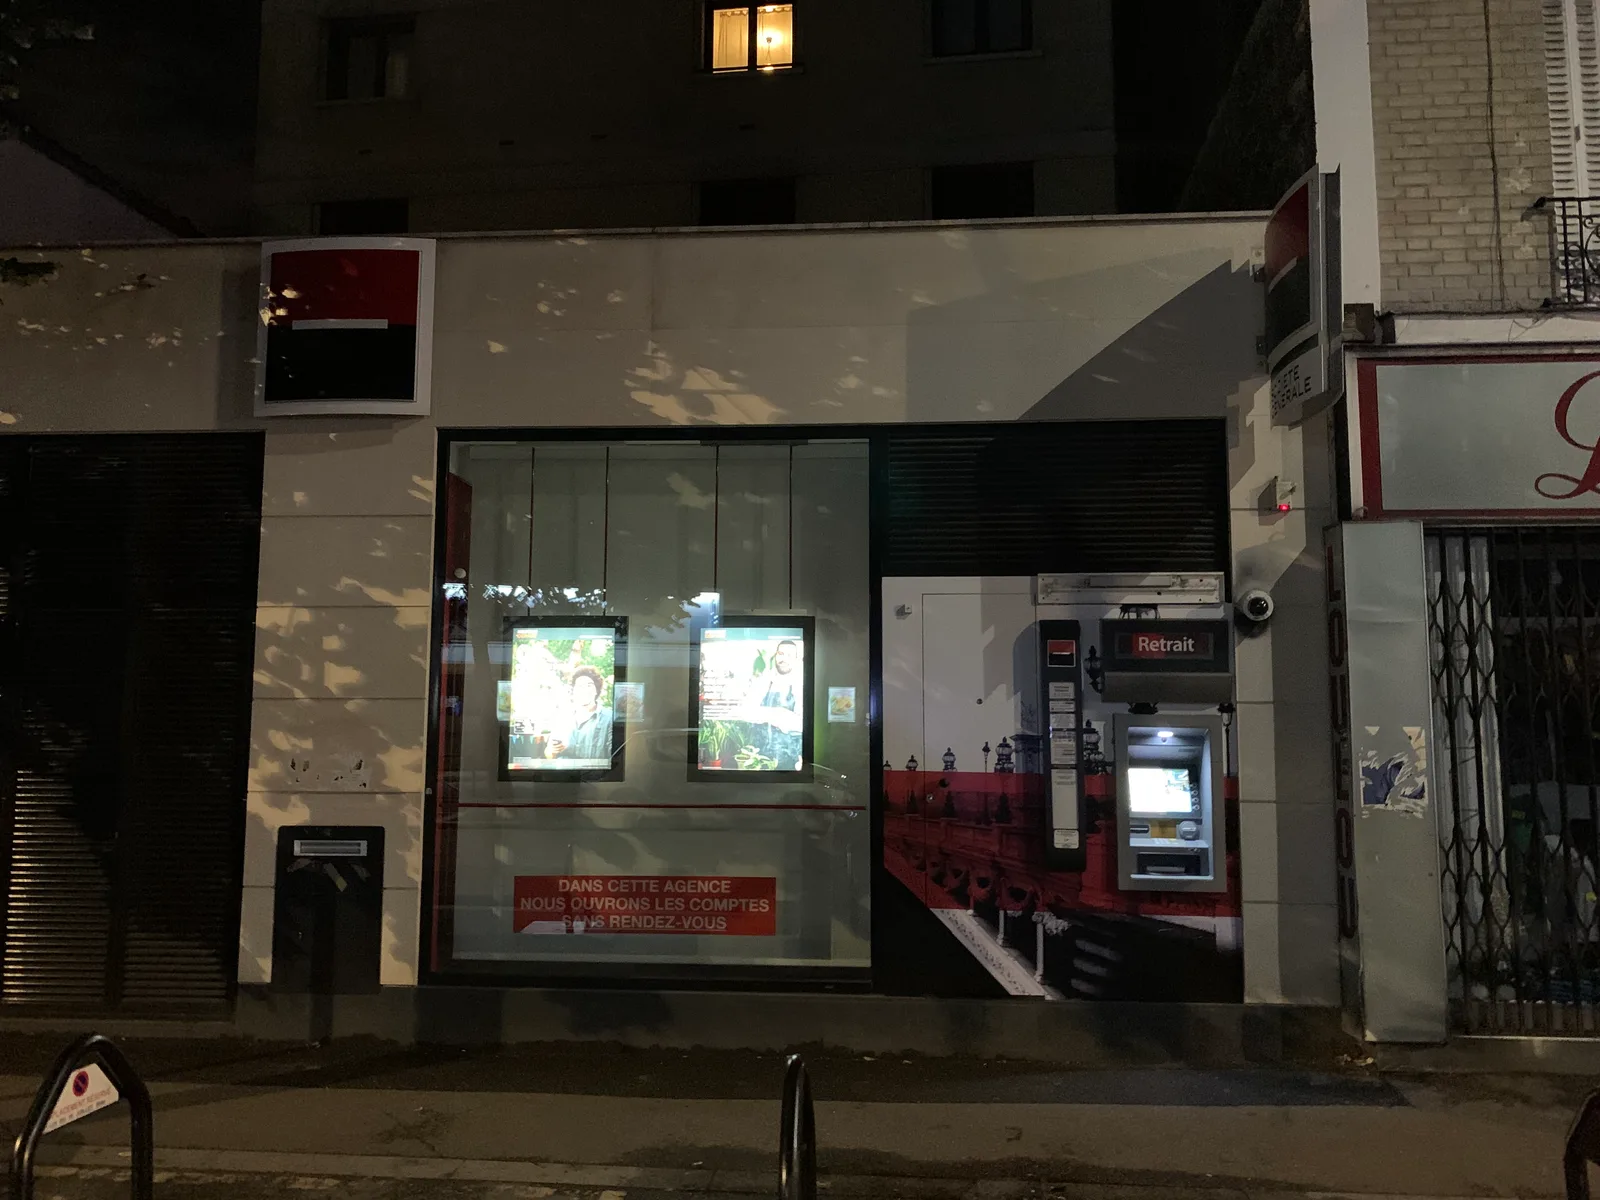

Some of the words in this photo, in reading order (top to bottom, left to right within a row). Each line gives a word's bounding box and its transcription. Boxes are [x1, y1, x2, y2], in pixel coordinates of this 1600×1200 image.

[1271, 375, 1311, 419] ENERALE
[1138, 636, 1195, 652] Retrait
[558, 879, 603, 893] DANS
[607, 879, 659, 893] CETTE
[663, 879, 731, 894] AGENCE
[520, 897, 566, 911] NOUS
[570, 897, 650, 911] OUVRONS
[655, 898, 685, 911] LES
[689, 898, 769, 912] COMPTES
[561, 914, 605, 929] SANS
[609, 915, 727, 930] RENDEZ-VOUS
